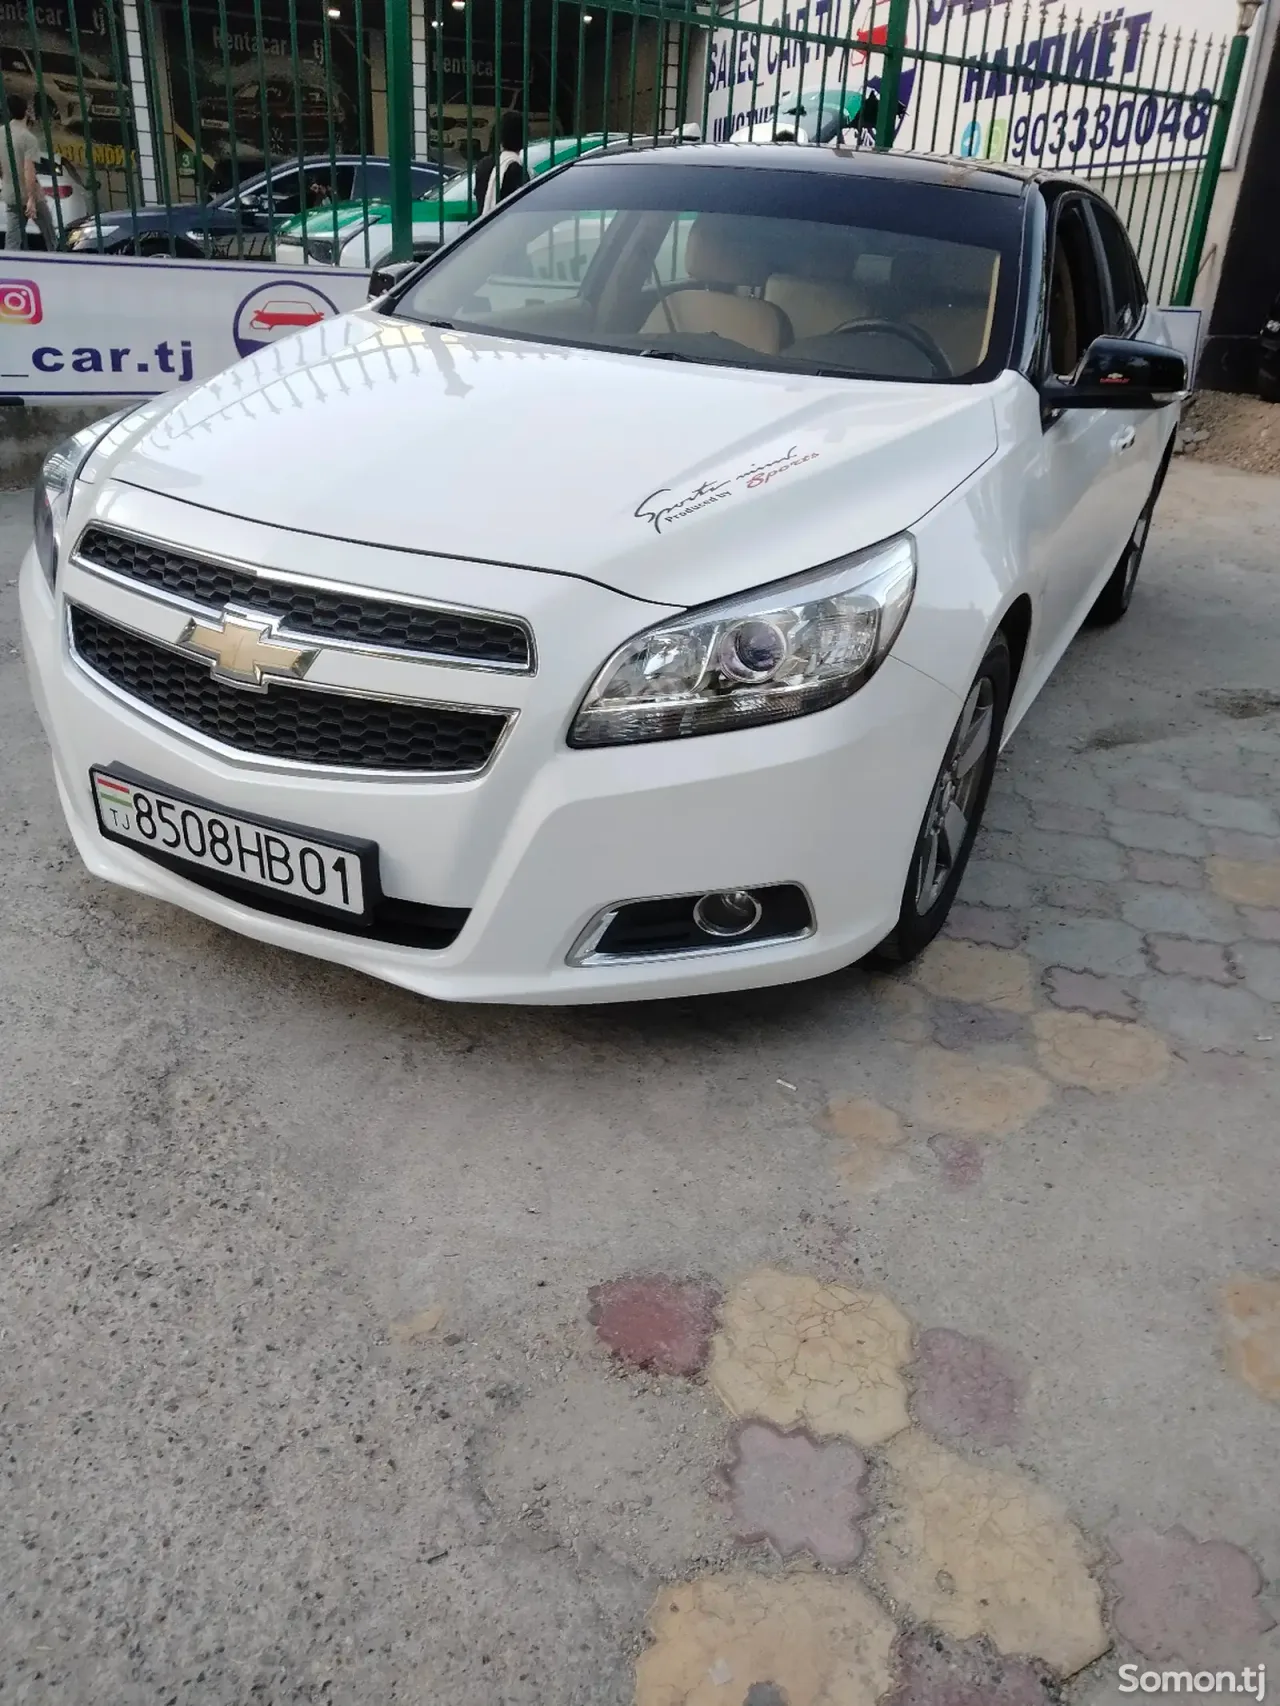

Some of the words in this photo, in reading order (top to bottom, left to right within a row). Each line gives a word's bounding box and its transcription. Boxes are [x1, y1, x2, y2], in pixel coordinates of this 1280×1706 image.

[182, 153, 191, 167] 3
[664, 496, 719, 523] Produced
[715, 488, 732, 498] by
[746, 452, 820, 489] Sports
[109, 807, 131, 831] TJ
[132, 792, 350, 905] 8508HB01
